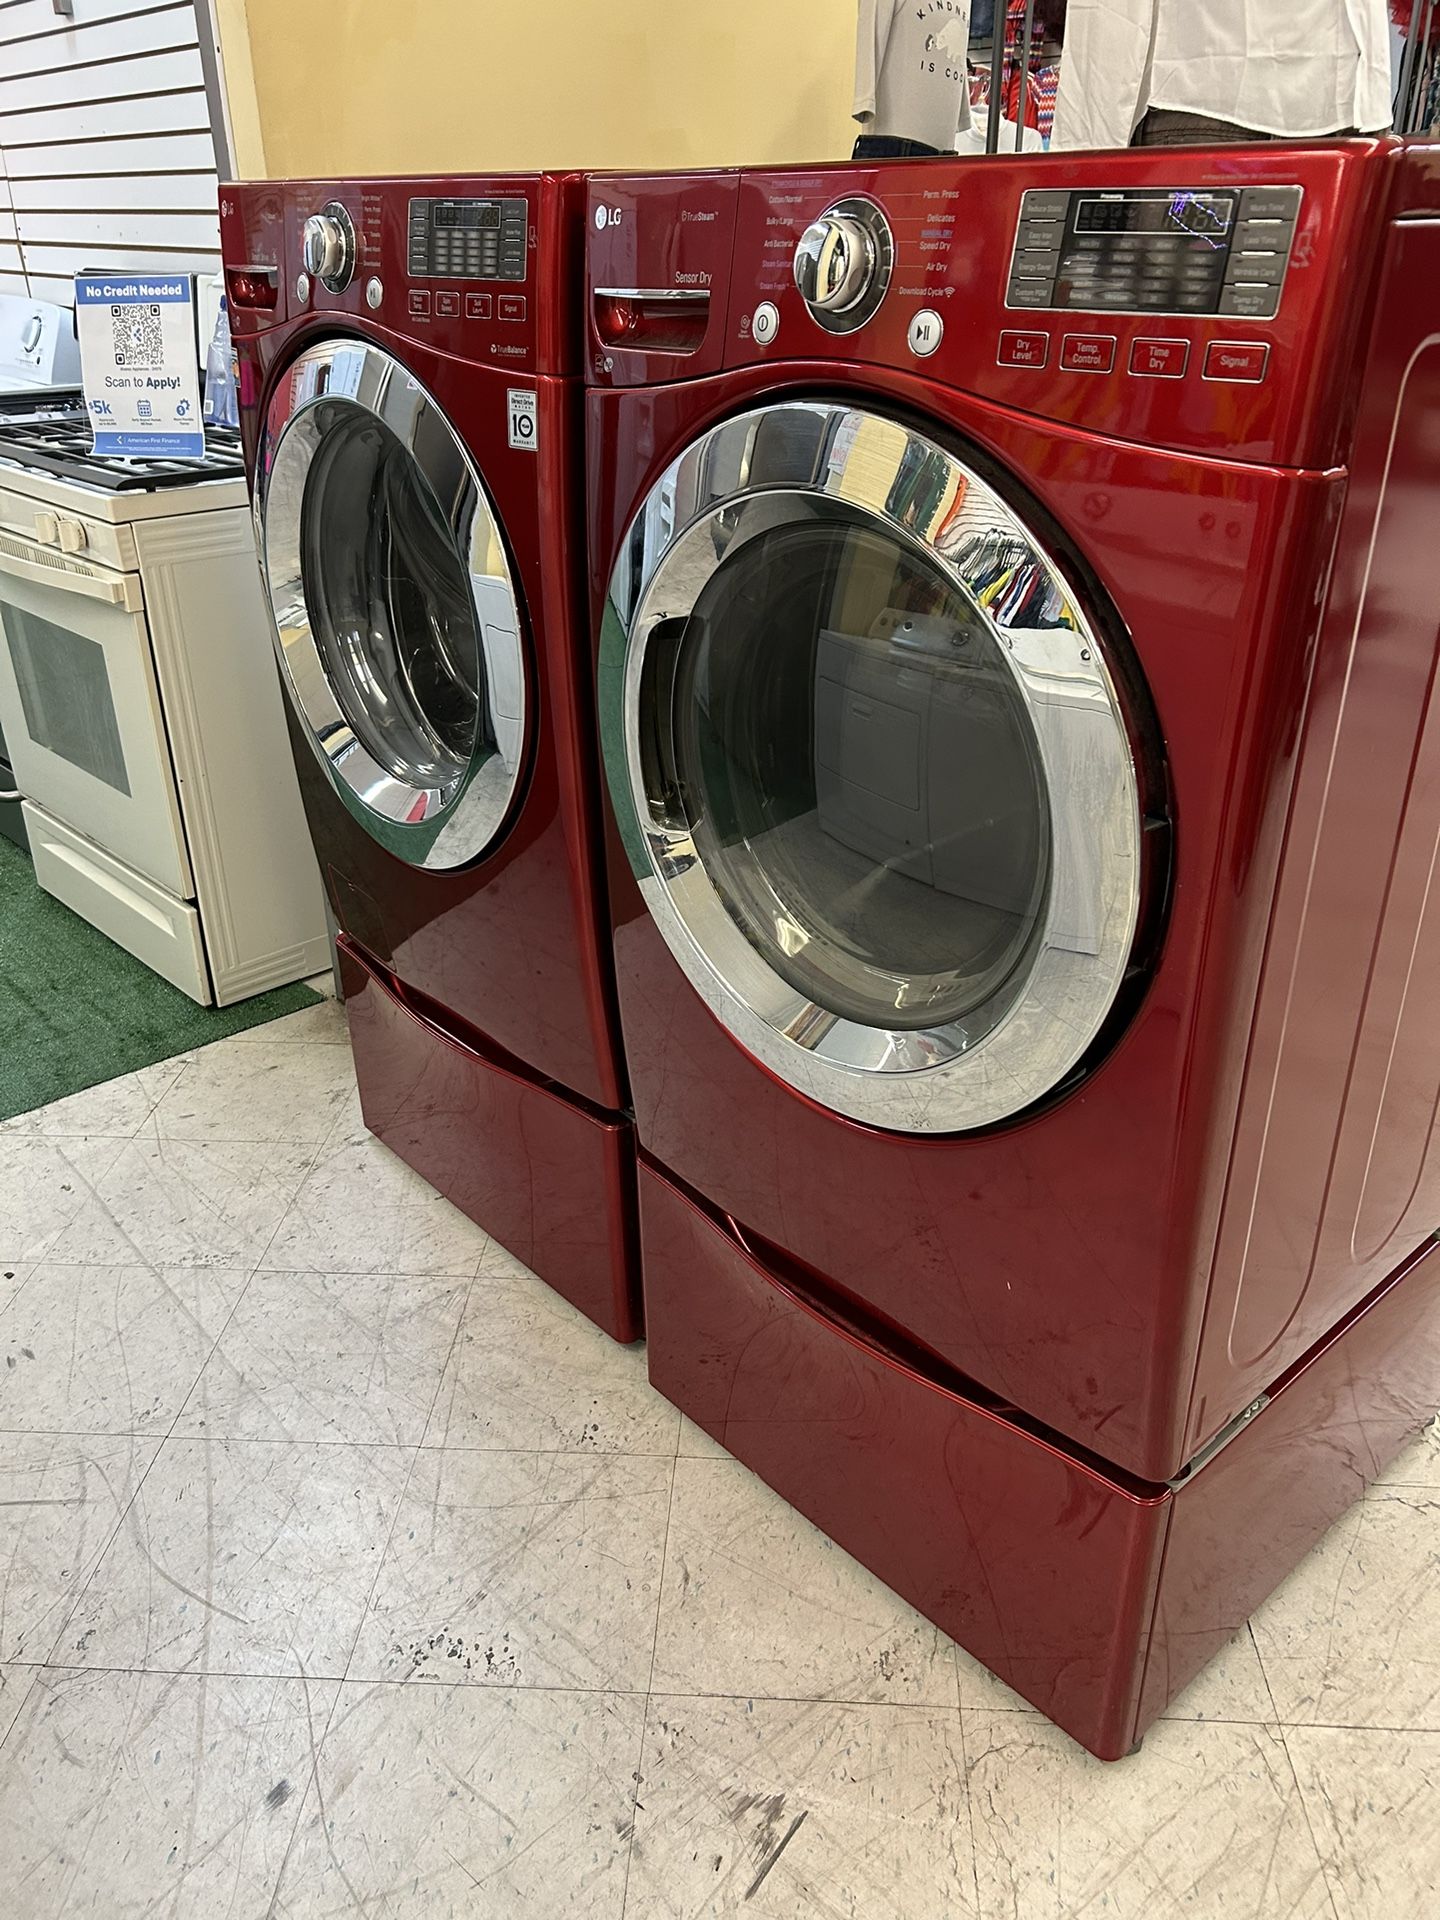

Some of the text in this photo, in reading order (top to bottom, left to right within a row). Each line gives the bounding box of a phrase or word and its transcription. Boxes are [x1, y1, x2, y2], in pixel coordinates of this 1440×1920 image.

[916, 1, 969, 27] KINDNE
[920, 61, 934, 72] IS
[941, 190, 960, 198] Press
[608, 208, 622, 226] LG
[766, 217, 795, 226] Bulky/Large
[927, 214, 956, 222] Delicates
[764, 240, 794, 248] Anti Bacterial
[920, 241, 952, 252] Speed Dry
[926, 262, 948, 272] Air Dry
[676, 271, 713, 286] Sensor Dry
[86, 284, 182, 297] No Credit Needed
[899, 286, 944, 298] Download Cycle
[1016, 338, 1030, 350] Dry
[1076, 342, 1098, 354] Temp
[497, 346, 528, 355] TrueBalance
[1012, 350, 1033, 361] Level
[1150, 346, 1170, 358] Time
[1072, 352, 1102, 365] Control
[1149, 357, 1166, 370] Dry
[1220, 355, 1250, 368] Signal
[105, 376, 181, 390] Scan to Apply!
[88, 400, 112, 415] $5k
[512, 414, 534, 438] 10
